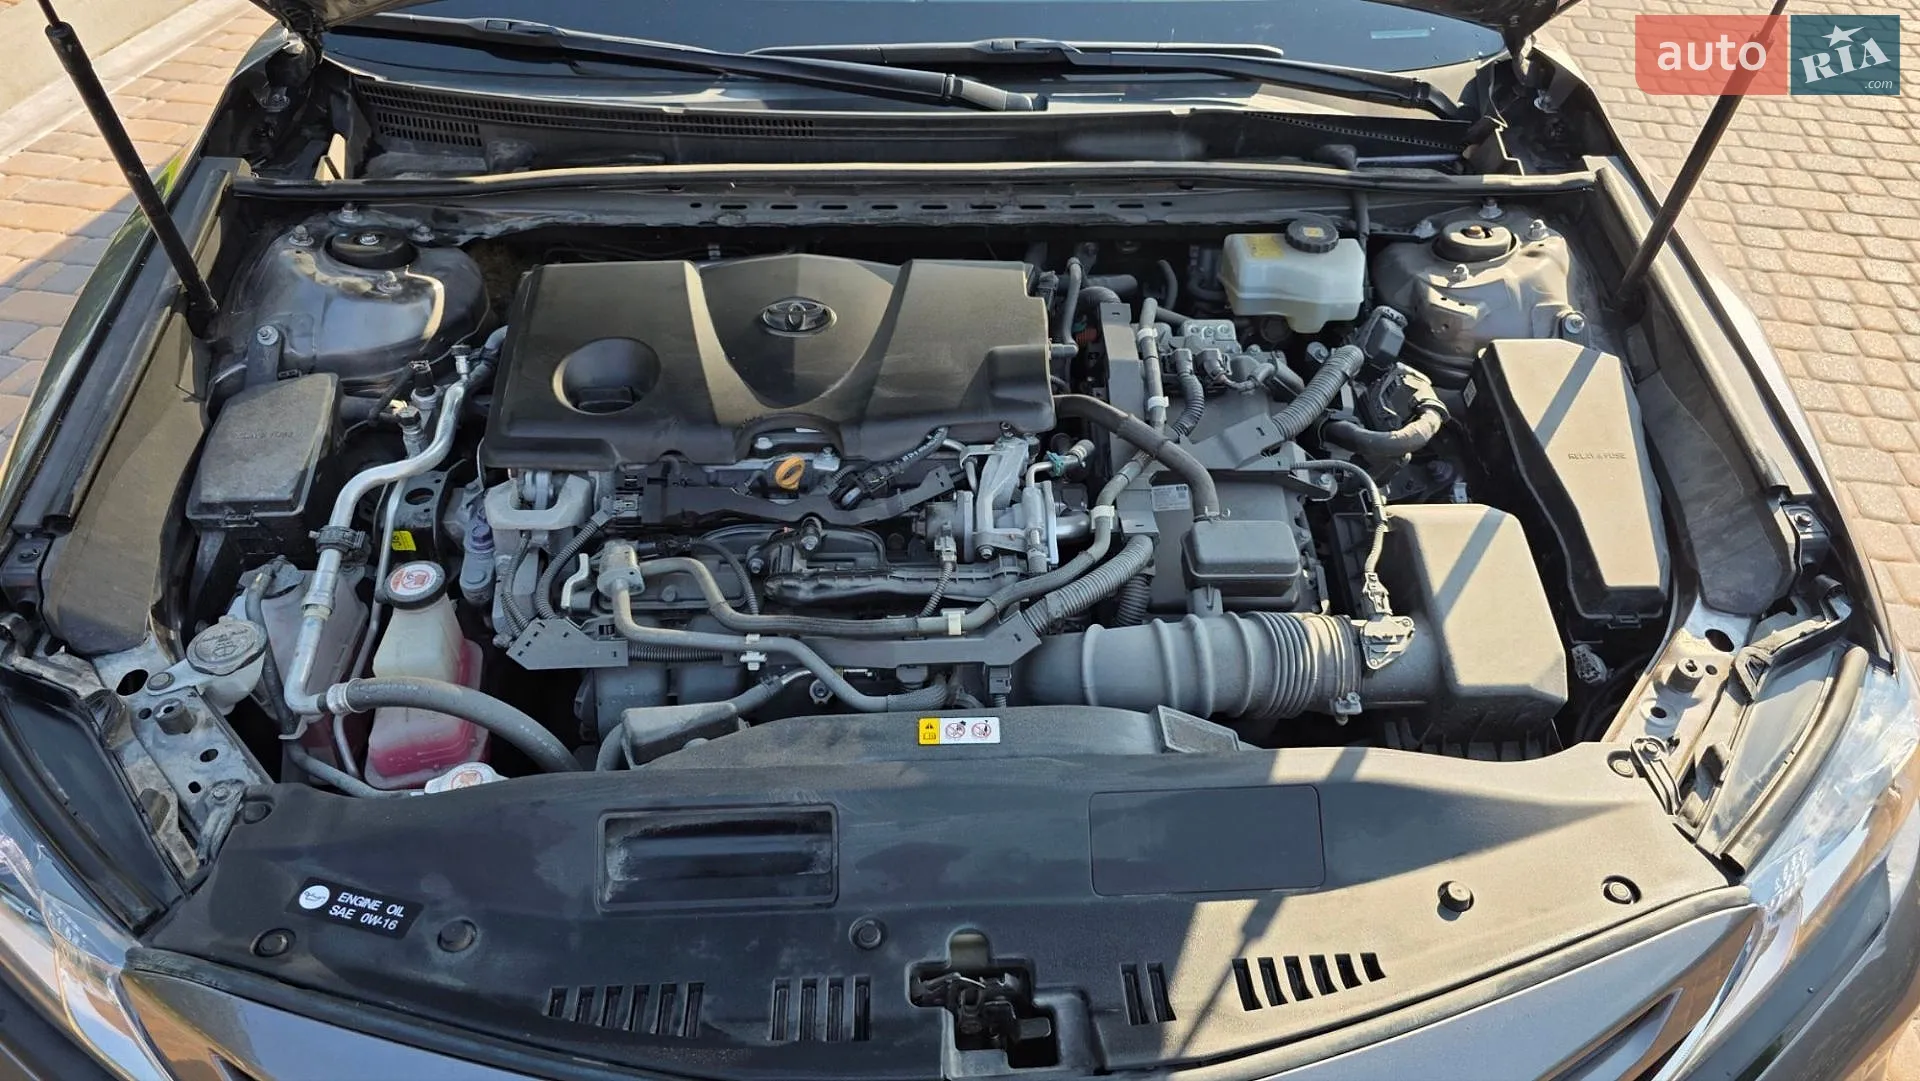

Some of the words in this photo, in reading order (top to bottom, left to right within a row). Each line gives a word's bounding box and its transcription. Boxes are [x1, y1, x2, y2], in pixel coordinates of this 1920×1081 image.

[329, 905, 356, 919] SAE
[360, 912, 399, 930] 0W-16
[338, 892, 382, 911] ENGINE
[386, 904, 405, 918] OIL
